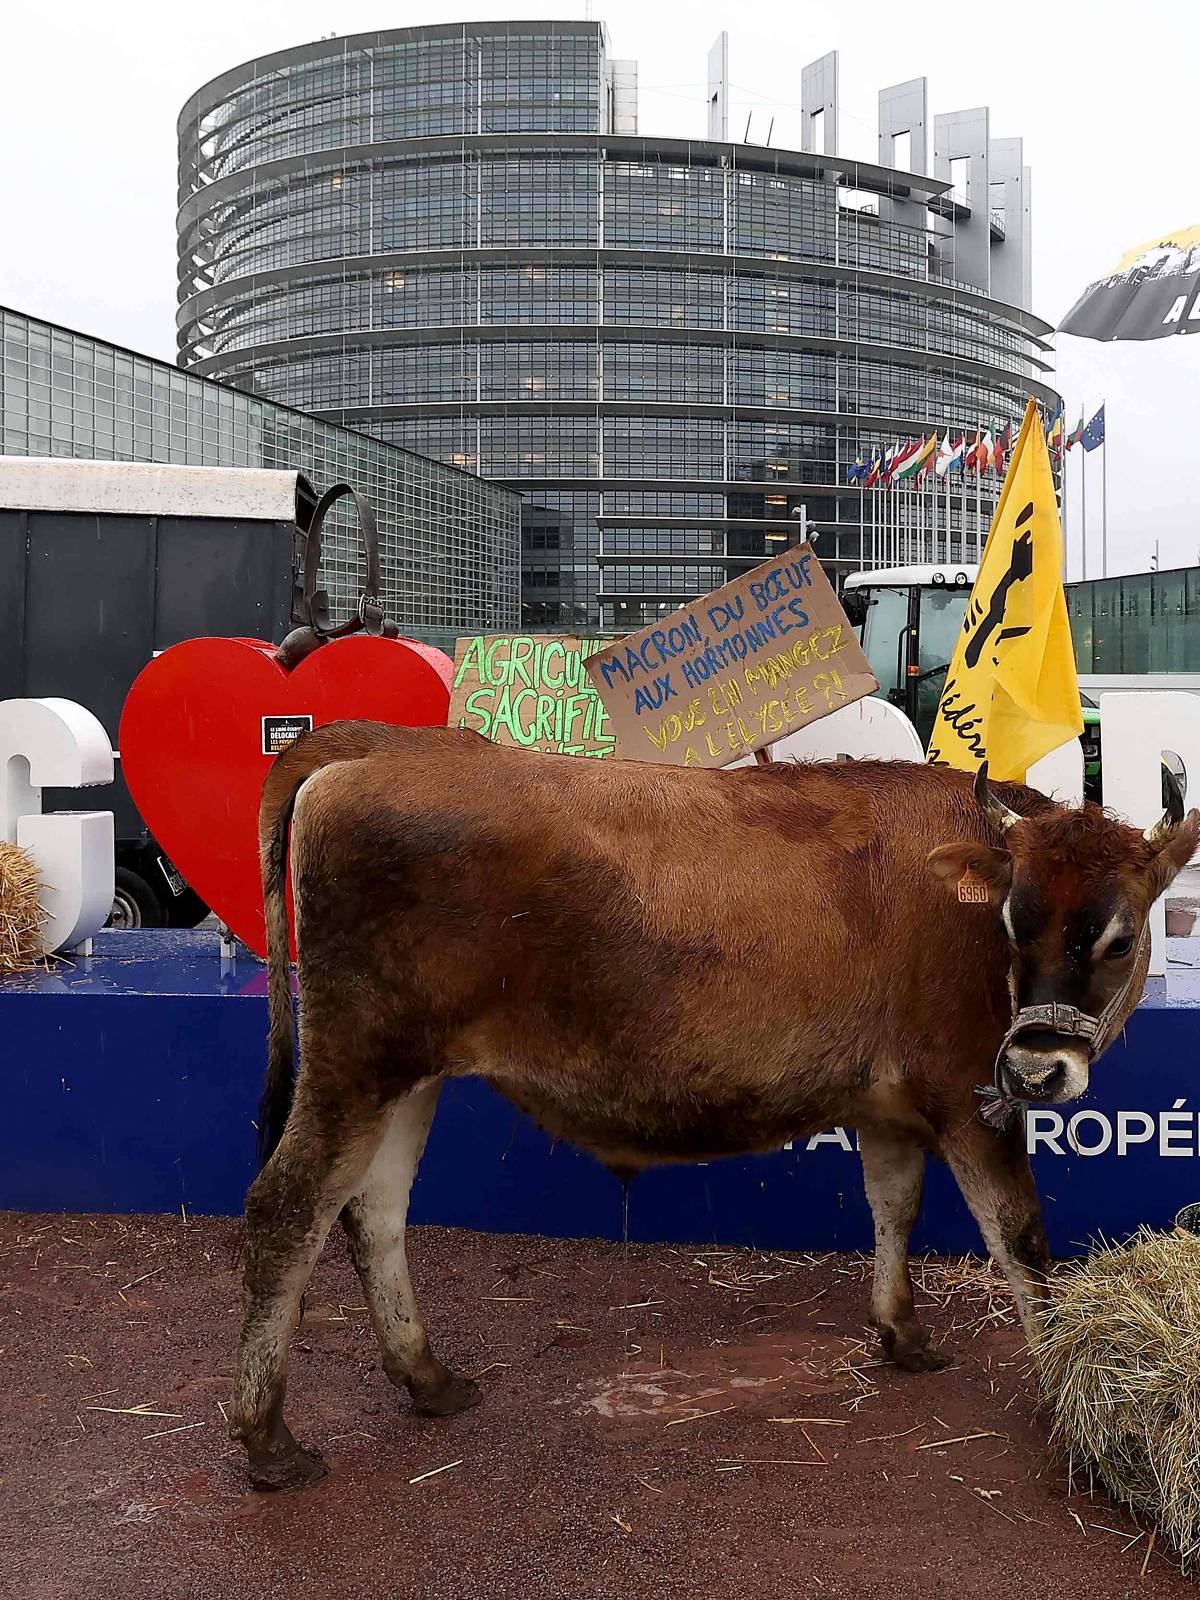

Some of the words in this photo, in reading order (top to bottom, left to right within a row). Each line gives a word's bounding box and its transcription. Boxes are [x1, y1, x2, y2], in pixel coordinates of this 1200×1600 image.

[1162, 295, 1188, 324] A
[600, 614, 701, 689] MACRON
[707, 595, 744, 632] DU
[634, 672, 678, 715] AUX
[643, 698, 707, 752] VOUS
[708, 678, 743, 717] EN
[745, 624, 848, 695] MANGEZ
[960, 886, 986, 901] 6960
